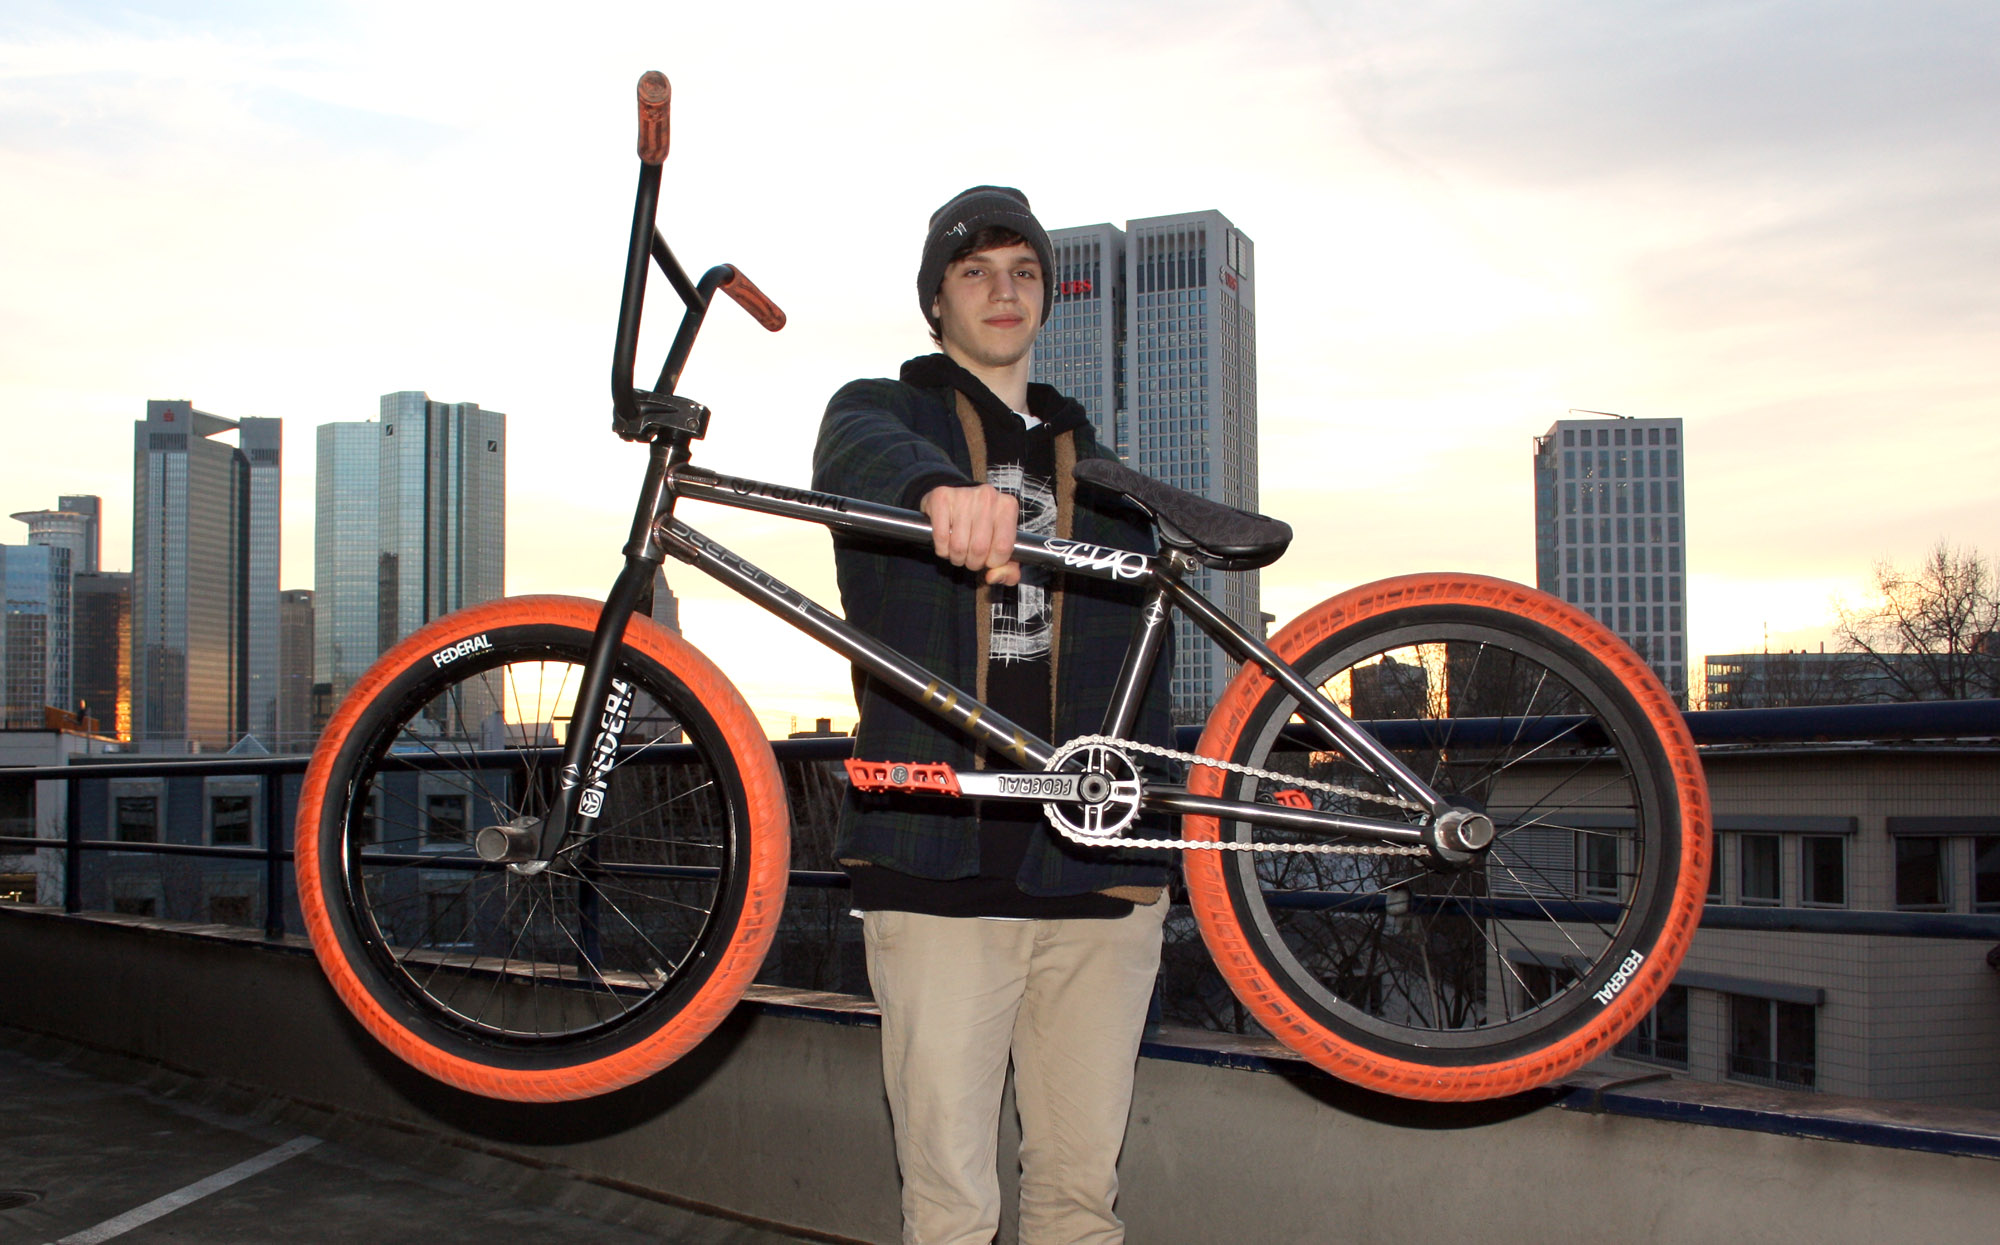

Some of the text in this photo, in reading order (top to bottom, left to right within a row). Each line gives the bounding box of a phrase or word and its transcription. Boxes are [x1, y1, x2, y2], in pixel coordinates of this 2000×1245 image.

[1060, 280, 1092, 295] UBS
[760, 485, 848, 513] FEDERAL
[432, 633, 493, 669] FEDERAL
[587, 677, 632, 789] FEDERA
[998, 776, 1073, 796] FEDERAL
[1592, 948, 1645, 1006] FEDERAL
